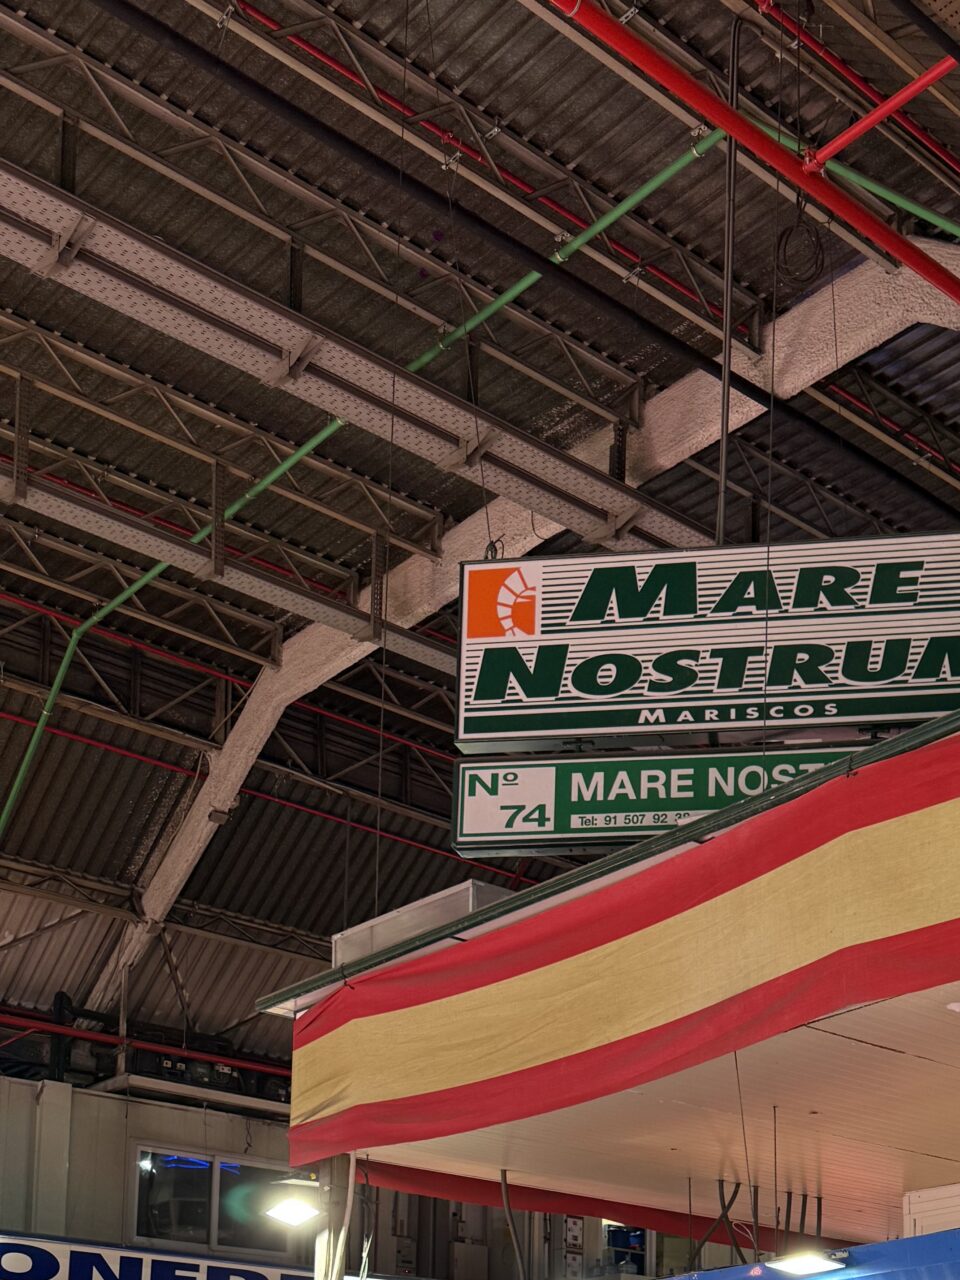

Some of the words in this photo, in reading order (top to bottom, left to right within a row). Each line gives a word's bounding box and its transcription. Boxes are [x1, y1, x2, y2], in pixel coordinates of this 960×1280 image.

[569, 561, 925, 622] MARE
[638, 702, 839, 724] MARISCOS
[570, 768, 695, 802] MARE
[500, 804, 551, 829] 74
[578, 815, 598, 826] Tel:
[604, 815, 618, 826] 91
[623, 813, 646, 825] 507
[652, 813, 668, 824] 92
